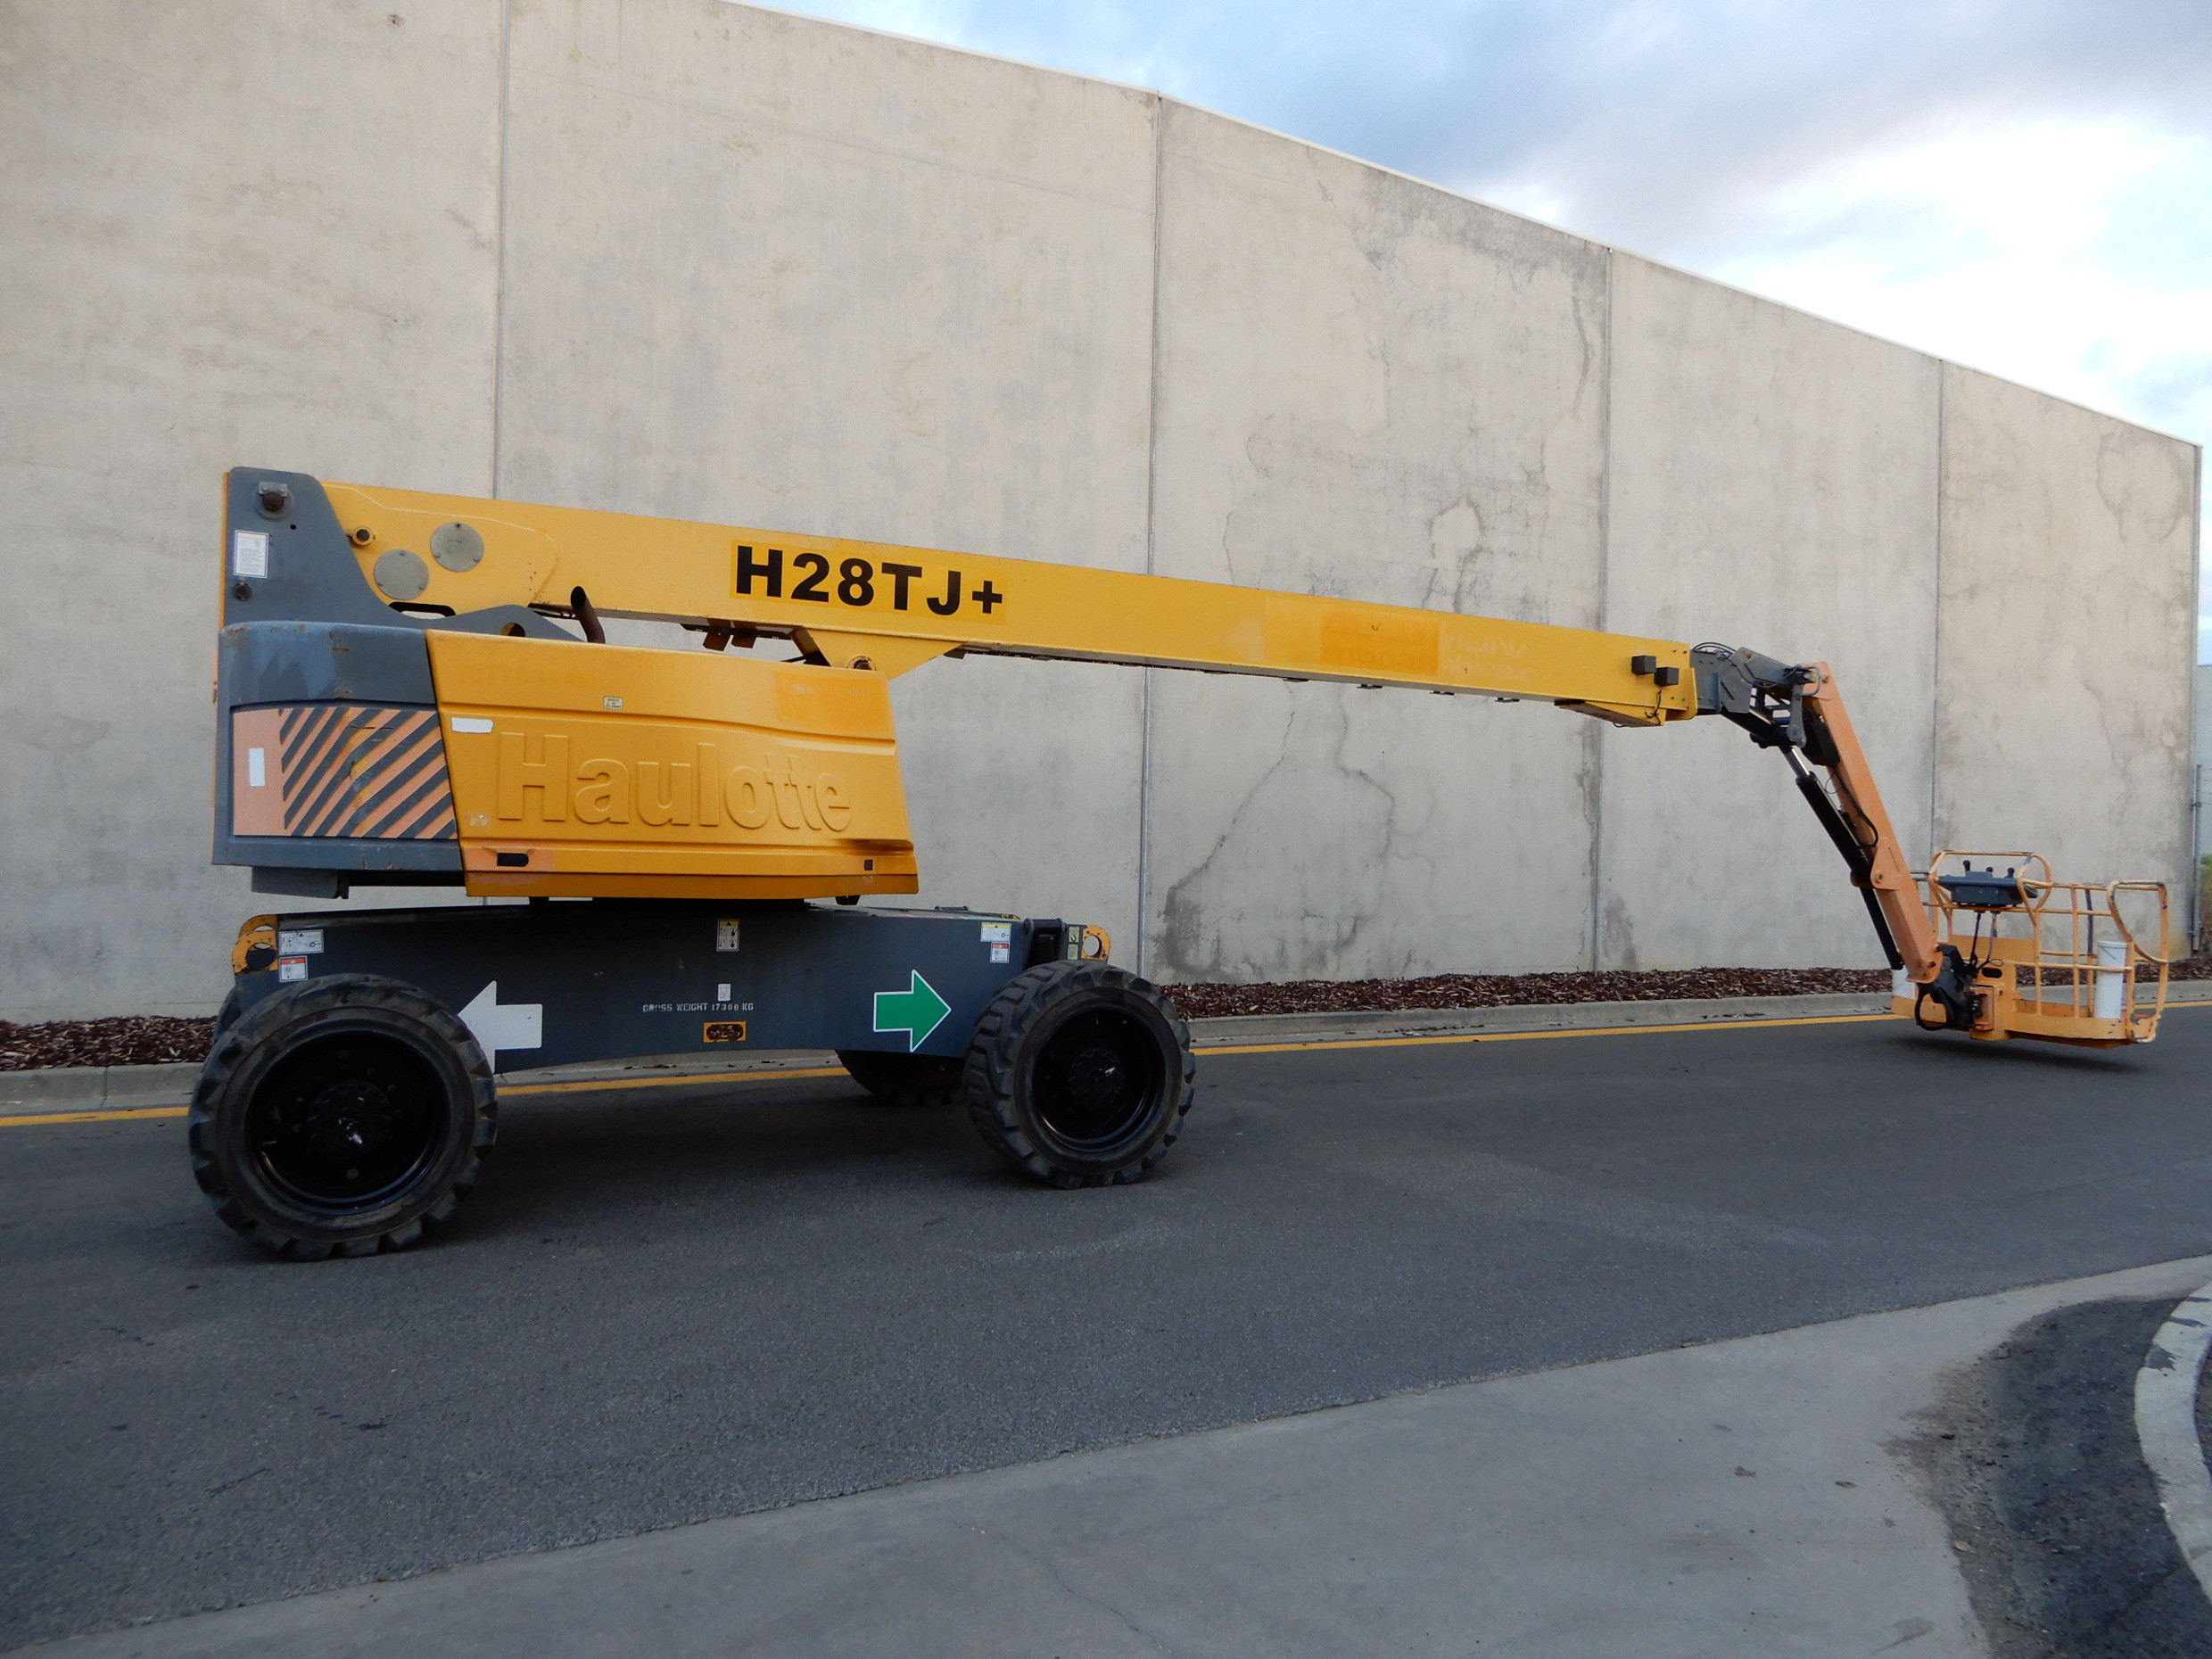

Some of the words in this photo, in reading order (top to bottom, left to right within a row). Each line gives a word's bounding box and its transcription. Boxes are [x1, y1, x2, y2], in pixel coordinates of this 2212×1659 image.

[736, 545, 1003, 615] H28TJ+
[496, 731, 852, 832] Haulotte
[676, 1003, 708, 1011] WEIGHT
[712, 1003, 739, 1011] 17300
[742, 1003, 754, 1011] KG
